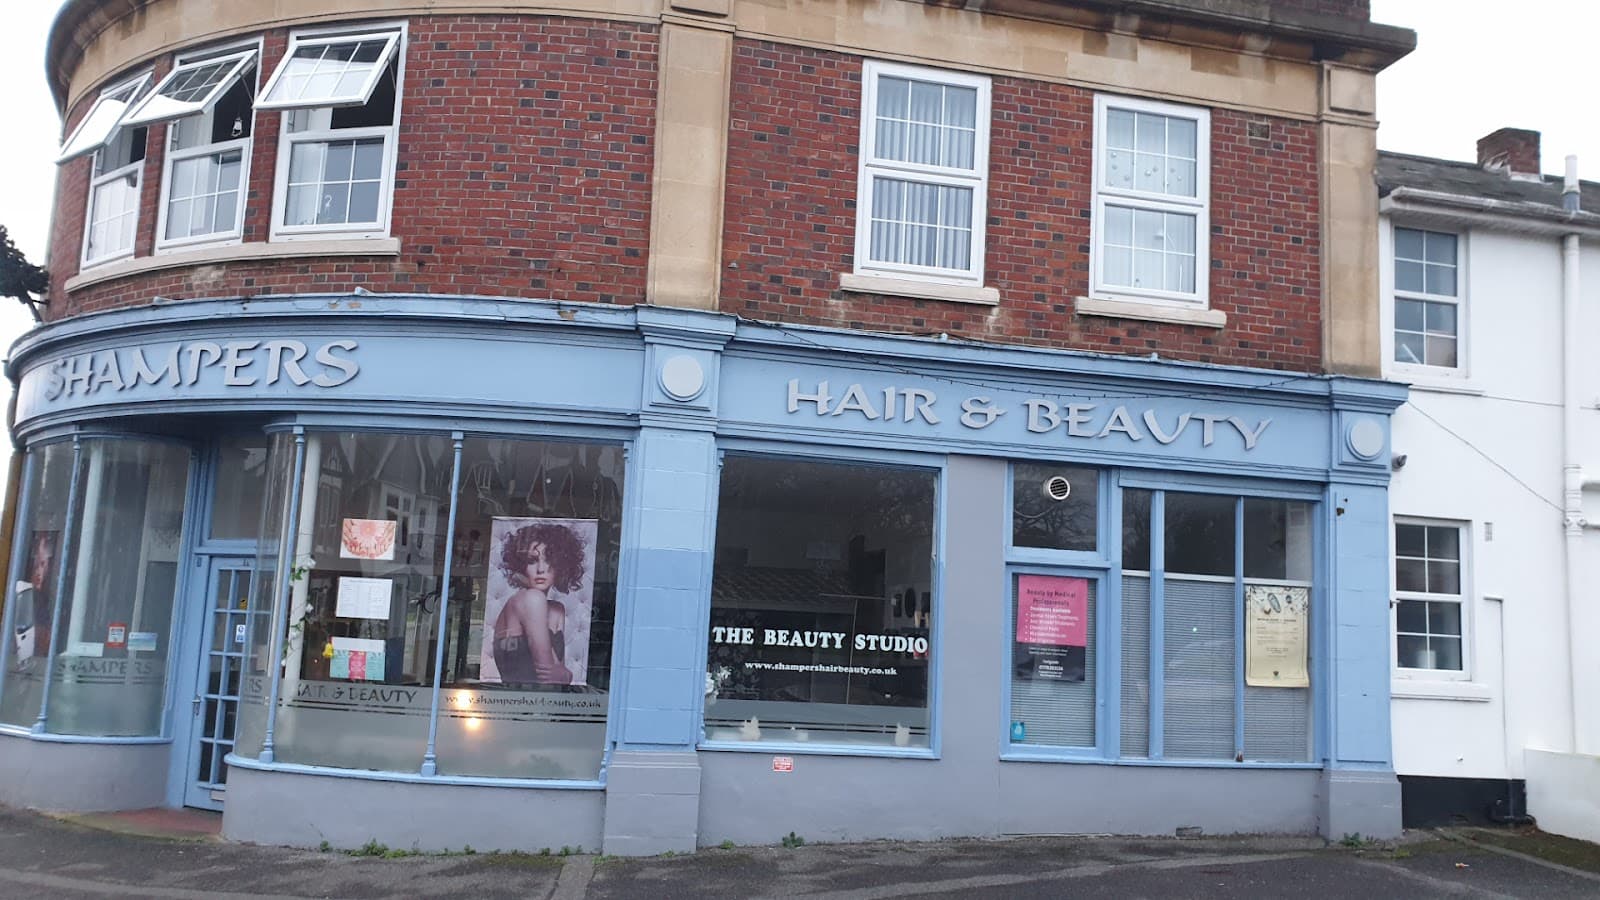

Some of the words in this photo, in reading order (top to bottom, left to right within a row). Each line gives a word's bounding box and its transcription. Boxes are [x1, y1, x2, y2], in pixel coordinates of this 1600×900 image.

[45, 339, 361, 401] SHAMPERS
[786, 377, 941, 425] HAIR
[960, 397, 1008, 429] &
[1023, 399, 1274, 449] BEAUTY
[712, 626, 755, 645] THE
[763, 628, 846, 649] BEAUTY
[854, 633, 929, 654] STUDIO
[744, 661, 898, 676] www.shampershairbeauty.co.uk
